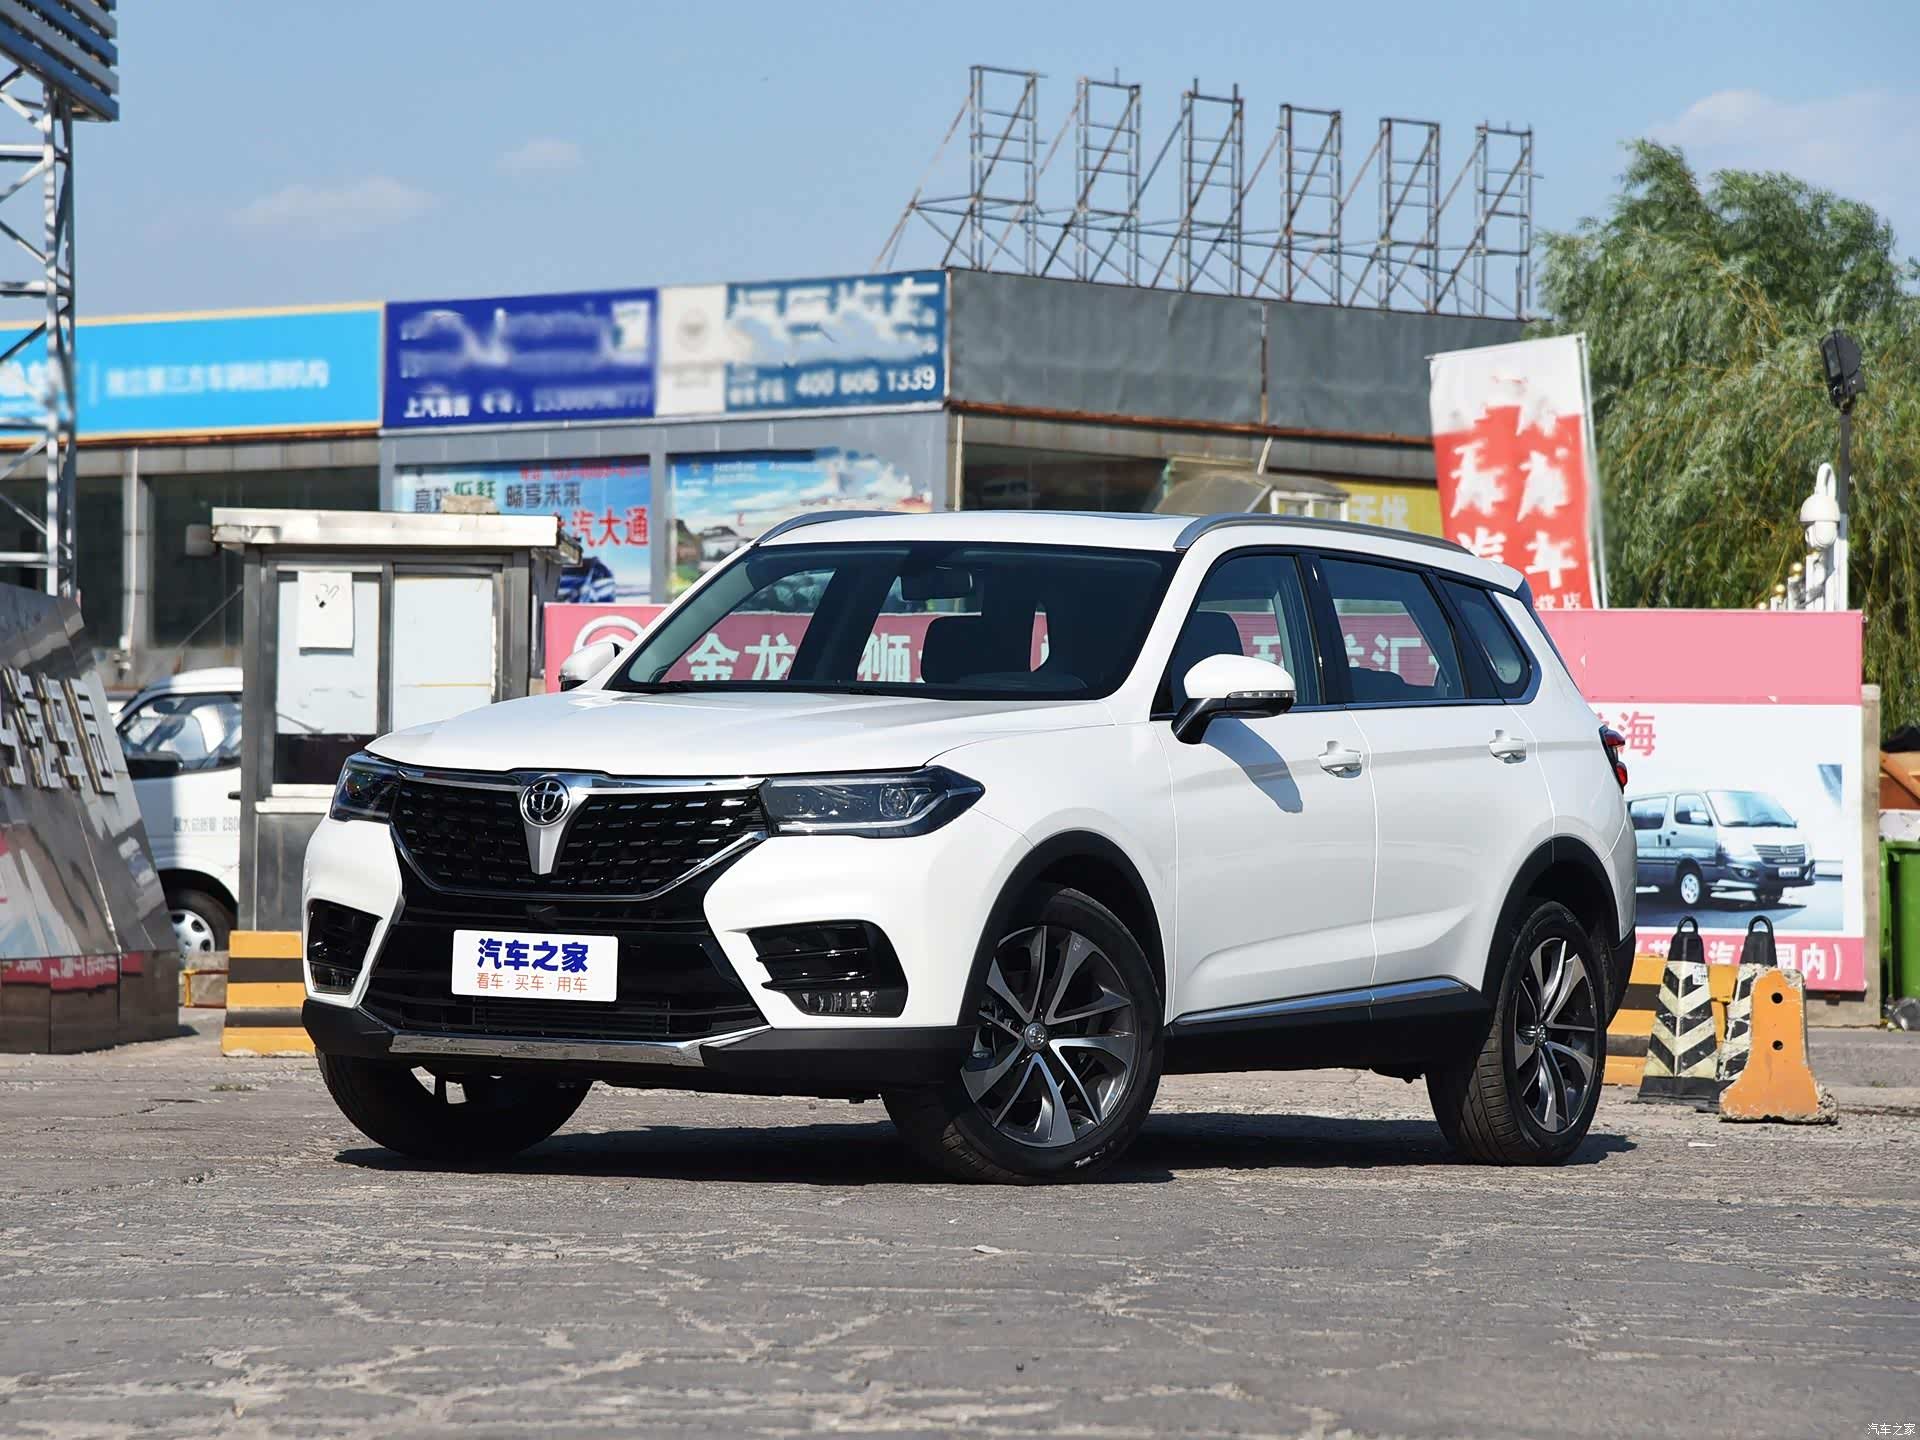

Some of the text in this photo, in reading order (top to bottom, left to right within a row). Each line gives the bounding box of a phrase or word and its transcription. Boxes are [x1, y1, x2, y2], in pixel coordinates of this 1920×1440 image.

[558, 505, 649, 547] 汽大通
[476, 938, 589, 973] 汽车之家
